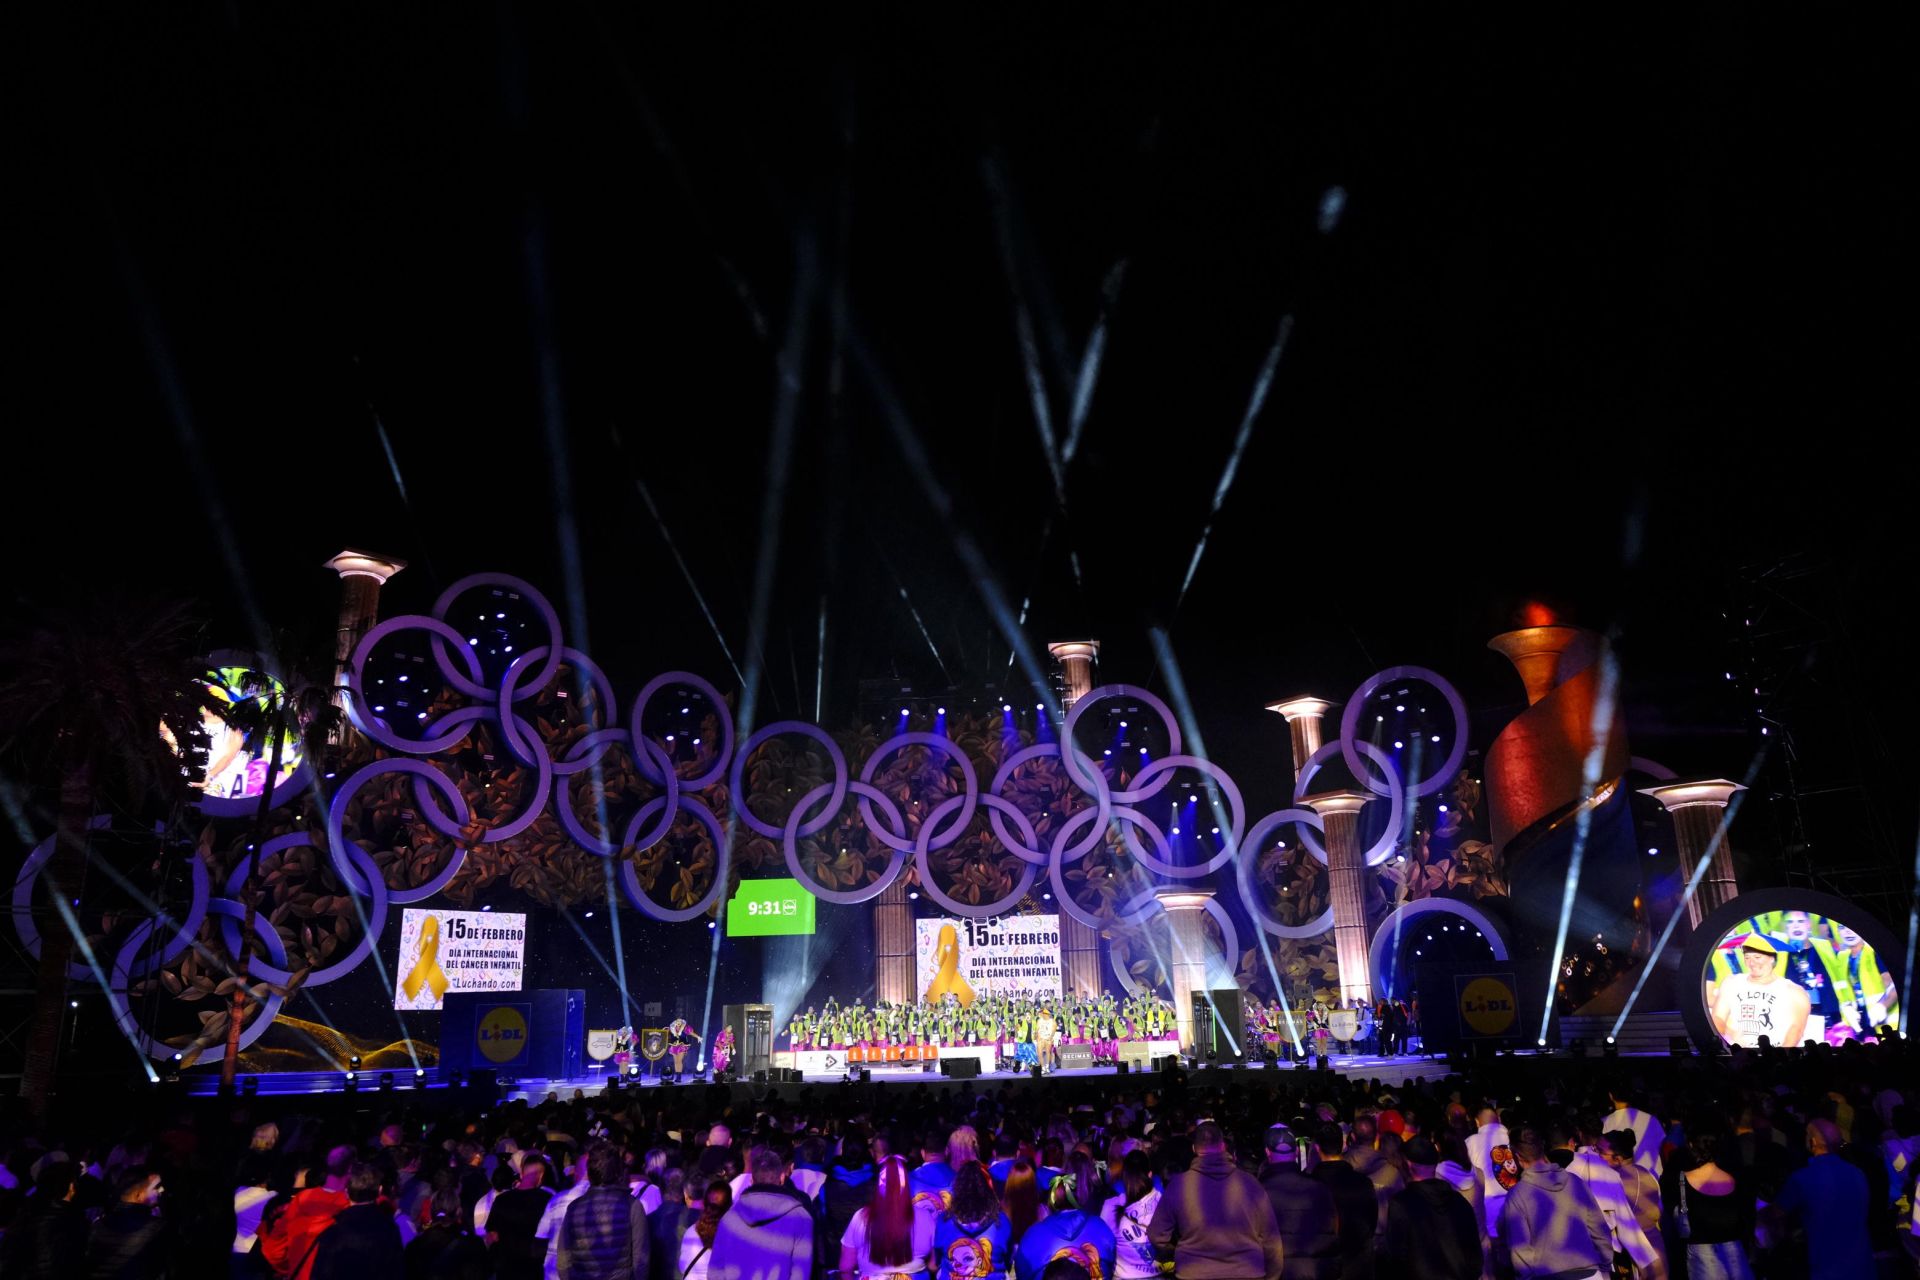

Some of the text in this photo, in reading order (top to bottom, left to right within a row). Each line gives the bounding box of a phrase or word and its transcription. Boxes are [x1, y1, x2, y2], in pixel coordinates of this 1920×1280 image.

[748, 901, 781, 915] 9:31
[446, 918, 523, 940] 15 DE FEBRERO
[965, 925, 1058, 946] 15 DE FEBRERO
[463, 949, 518, 958] INTERNACIONAL
[446, 960, 459, 969] DEL
[490, 961, 520, 969] INFANTIL
[989, 955, 1055, 965] INTERNACIONAL
[970, 969, 984, 978] DEL
[1022, 967, 1059, 976] INFANTIL
[500, 980, 515, 988] con
